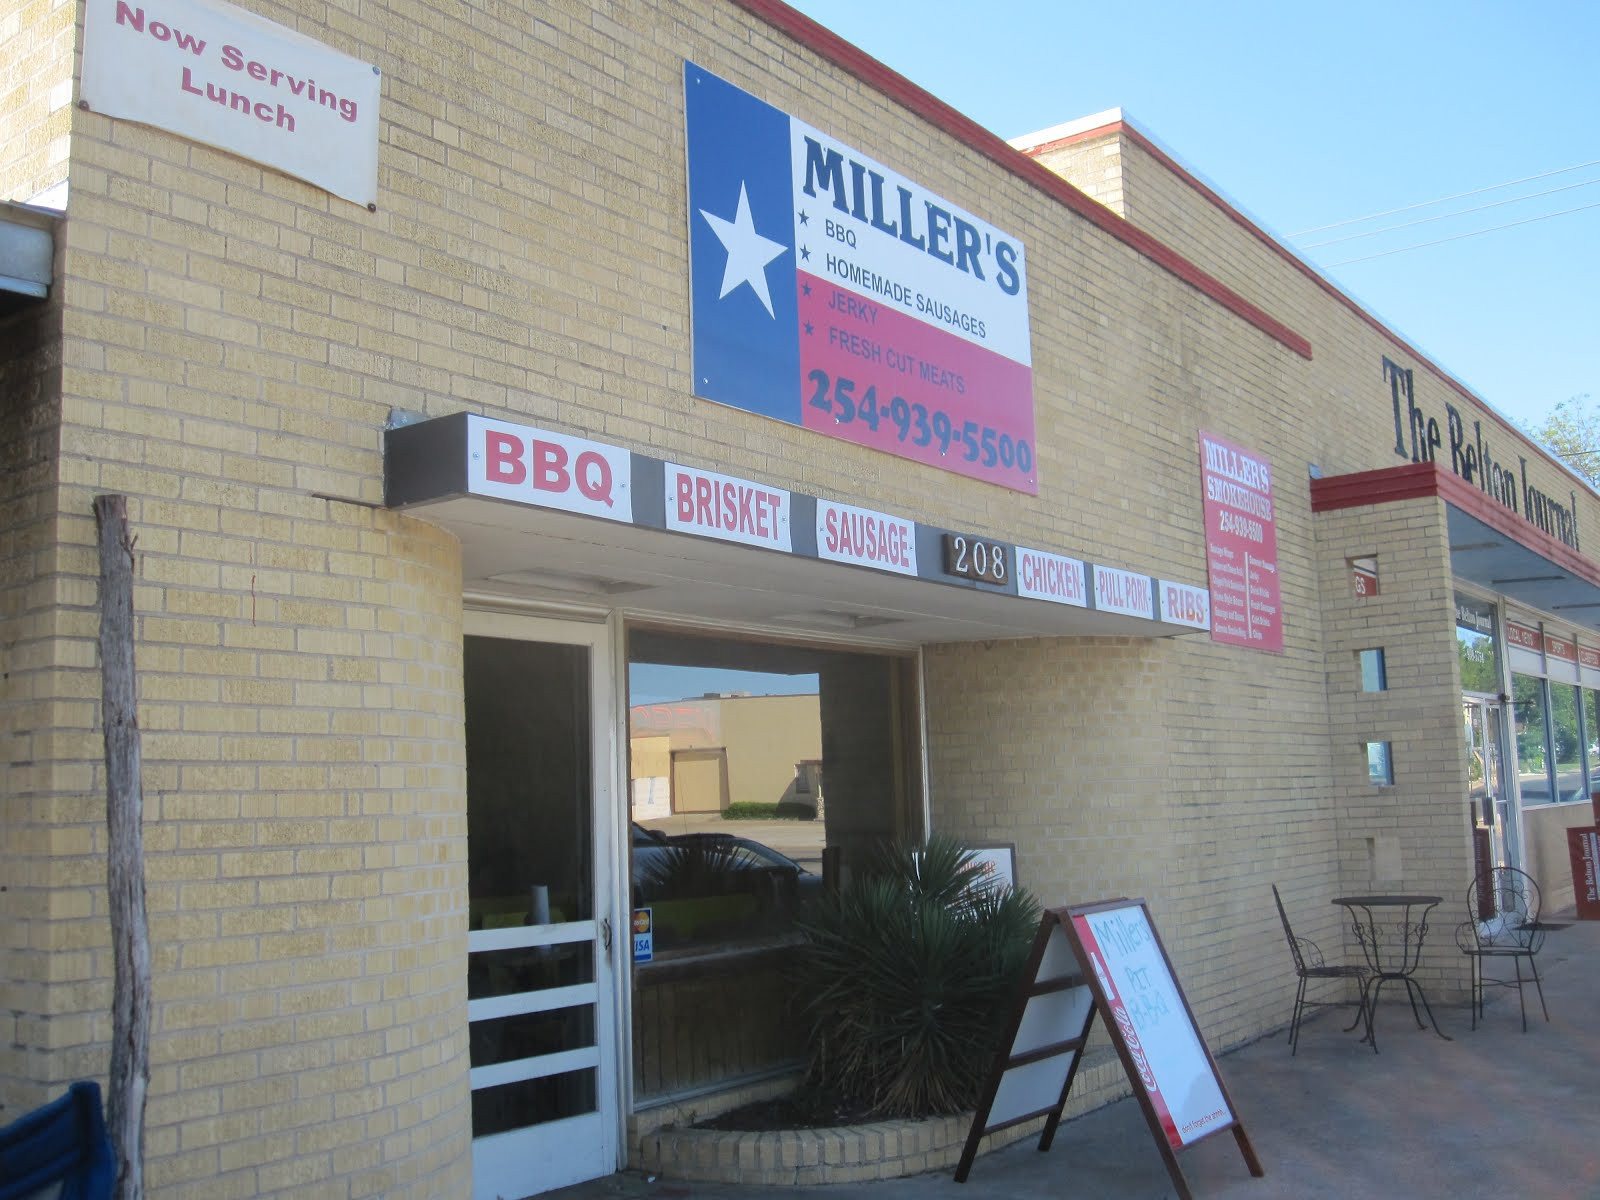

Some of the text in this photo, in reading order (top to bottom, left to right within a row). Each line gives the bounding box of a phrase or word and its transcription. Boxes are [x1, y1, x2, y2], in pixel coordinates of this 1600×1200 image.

[115, 0, 358, 123] Now Serving
[181, 66, 297, 133] Lunch
[803, 135, 1021, 296] MILLER'S
[825, 218, 857, 250] BBQ
[827, 252, 987, 339] HOMEMADE SAUSAGES
[828, 290, 878, 325] JERKY
[829, 326, 966, 394] FRESH CUT MEATS
[807, 368, 1032, 473] 254-939-5500
[485, 429, 614, 509] BBQ
[1382, 354, 1580, 552] The Belton Journal
[676, 472, 781, 541] BRISKET
[1207, 474, 1272, 522] SMOKEHOUSE
[825, 507, 910, 569] SAUSAGE
[953, 536, 1006, 580] 208
[1022, 553, 1082, 600] CHICKEN
[1099, 570, 1150, 613] PULL PORK
[1167, 587, 1205, 624] RIBS
[634, 939, 650, 952] ISA
